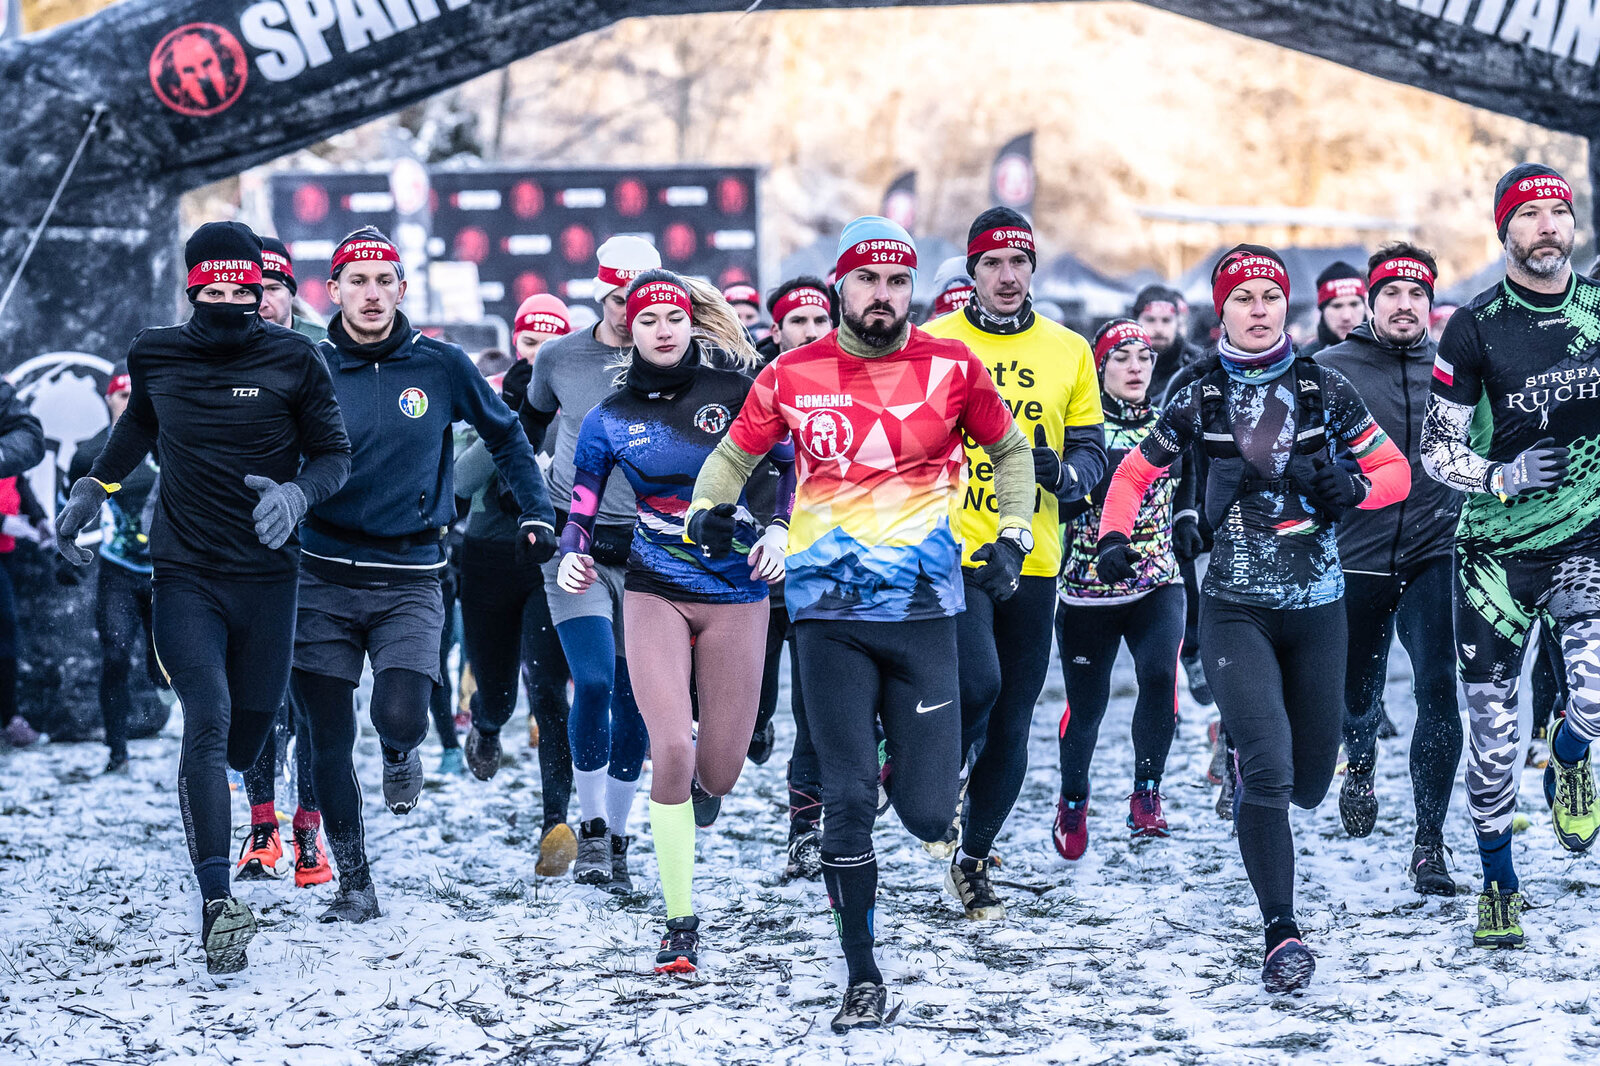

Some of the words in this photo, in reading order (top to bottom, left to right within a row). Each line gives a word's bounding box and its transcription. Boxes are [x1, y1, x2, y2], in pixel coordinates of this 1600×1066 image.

[1534, 178, 1570, 193] SPARTAN
[1535, 187, 1565, 197] 3611
[355, 241, 391, 251] SPARTAN
[870, 241, 912, 255] SPARTAN
[261, 252, 287, 266] PARTAN
[354, 250, 383, 259] 3679
[871, 252, 904, 263] 3647
[213, 260, 252, 270] SPARTAN
[262, 262, 281, 271] 502
[1242, 257, 1284, 276] SPARTAN
[1397, 260, 1429, 276] SPARTAN
[213, 272, 244, 281] 3624
[1244, 266, 1275, 277] 3523
[649, 283, 686, 299] SPARTAN
[650, 292, 677, 303] 3561
[1526, 367, 1600, 388] STREFA
[232, 388, 259, 397] TCA
[795, 394, 853, 408] ROMANIA
